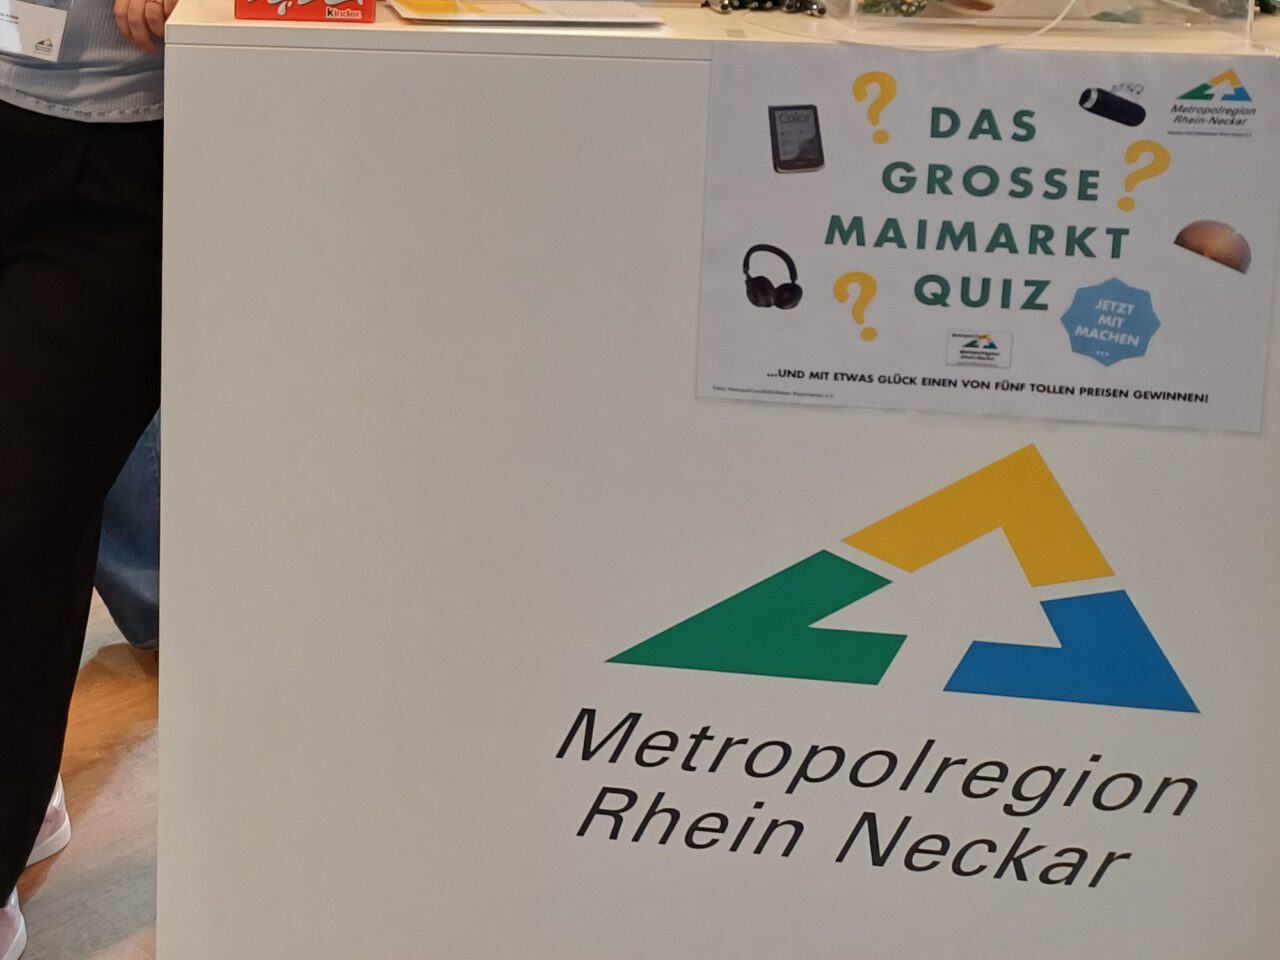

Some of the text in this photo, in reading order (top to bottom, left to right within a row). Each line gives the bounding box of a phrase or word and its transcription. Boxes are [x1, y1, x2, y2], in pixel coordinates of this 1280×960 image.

[929, 106, 1036, 142] DAS
[1170, 104, 1256, 116] Metropolregion
[1173, 115, 1248, 126] Rhein-Neckar
[882, 161, 1100, 201] GROSSE
[824, 214, 1130, 259] MAIMARKT
[914, 274, 1051, 311] QUIZ
[1094, 299, 1136, 315] JETZT
[1075, 325, 1140, 347] MACHEN
[1098, 314, 1124, 328] MIT
[766, 368, 1209, 403] ...UND MIT ETWAS GLÜCK EINEN VON FÜNF TOLLEN PREISEN GEWINNEN!
[555, 707, 1199, 817] Metropolregion
[576, 786, 1133, 888] Rhein Neckar
